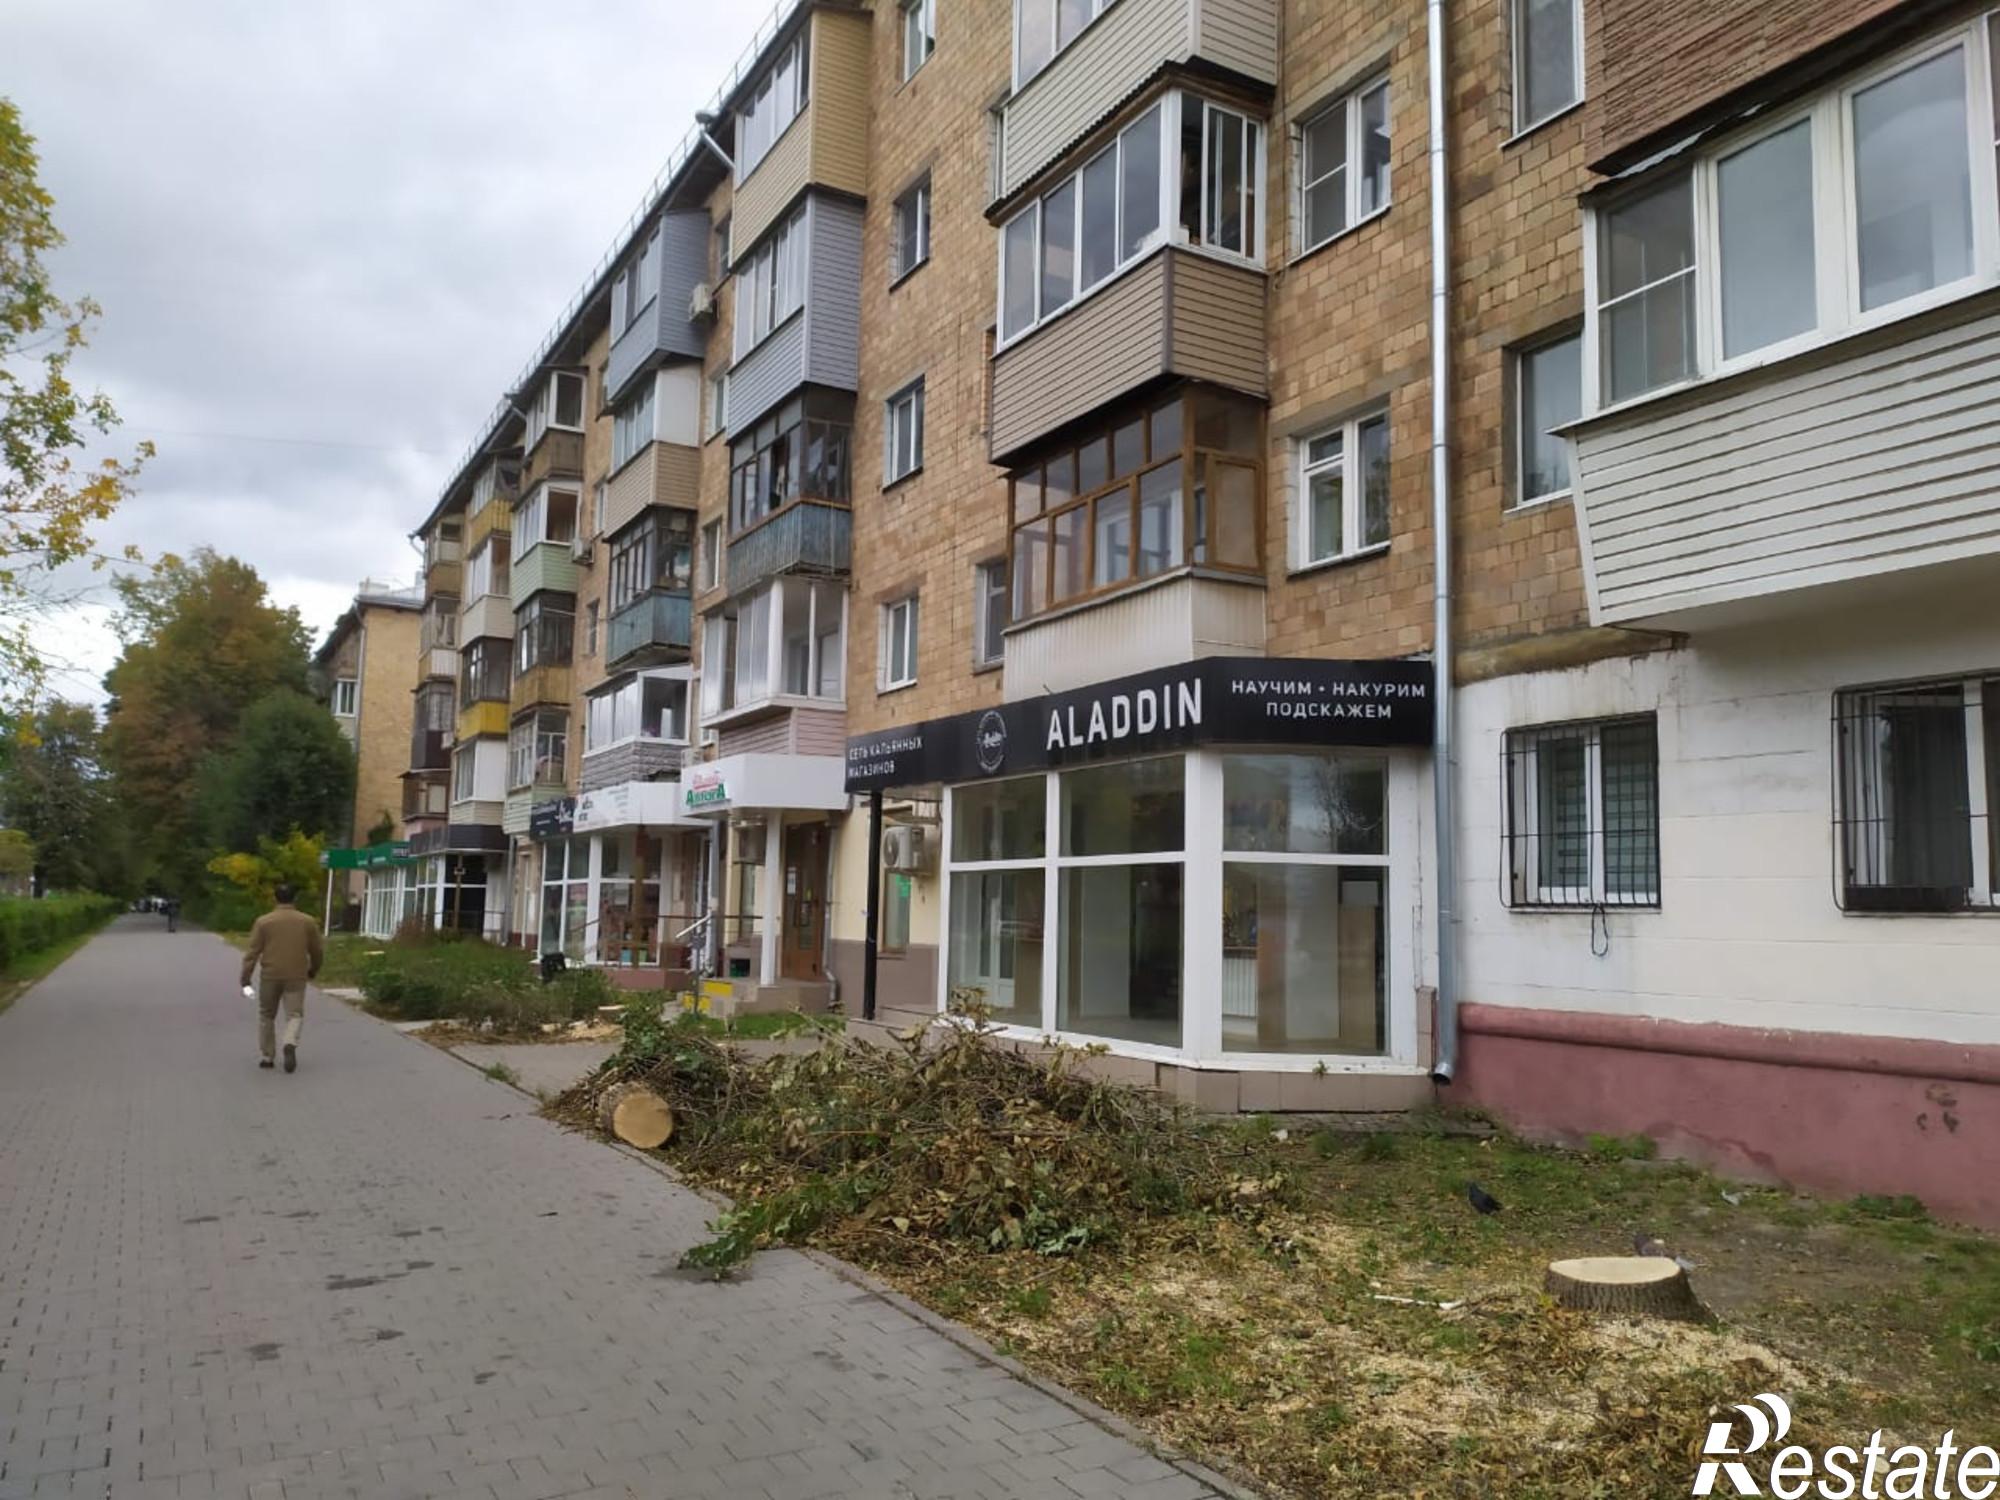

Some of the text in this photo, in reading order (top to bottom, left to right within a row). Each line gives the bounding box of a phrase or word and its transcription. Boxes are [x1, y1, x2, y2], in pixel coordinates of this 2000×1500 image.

[1231, 680, 1425, 698] НАУЧИМ НАКУРИМ
[1046, 678, 1202, 750] ALADDIN
[1266, 702, 1392, 719] ПОДСКАЖЕМ
[849, 736, 923, 760] СЕТЬ КАЛЬЯННЫХ
[849, 760, 895, 778] МАГАЗИНОВ
